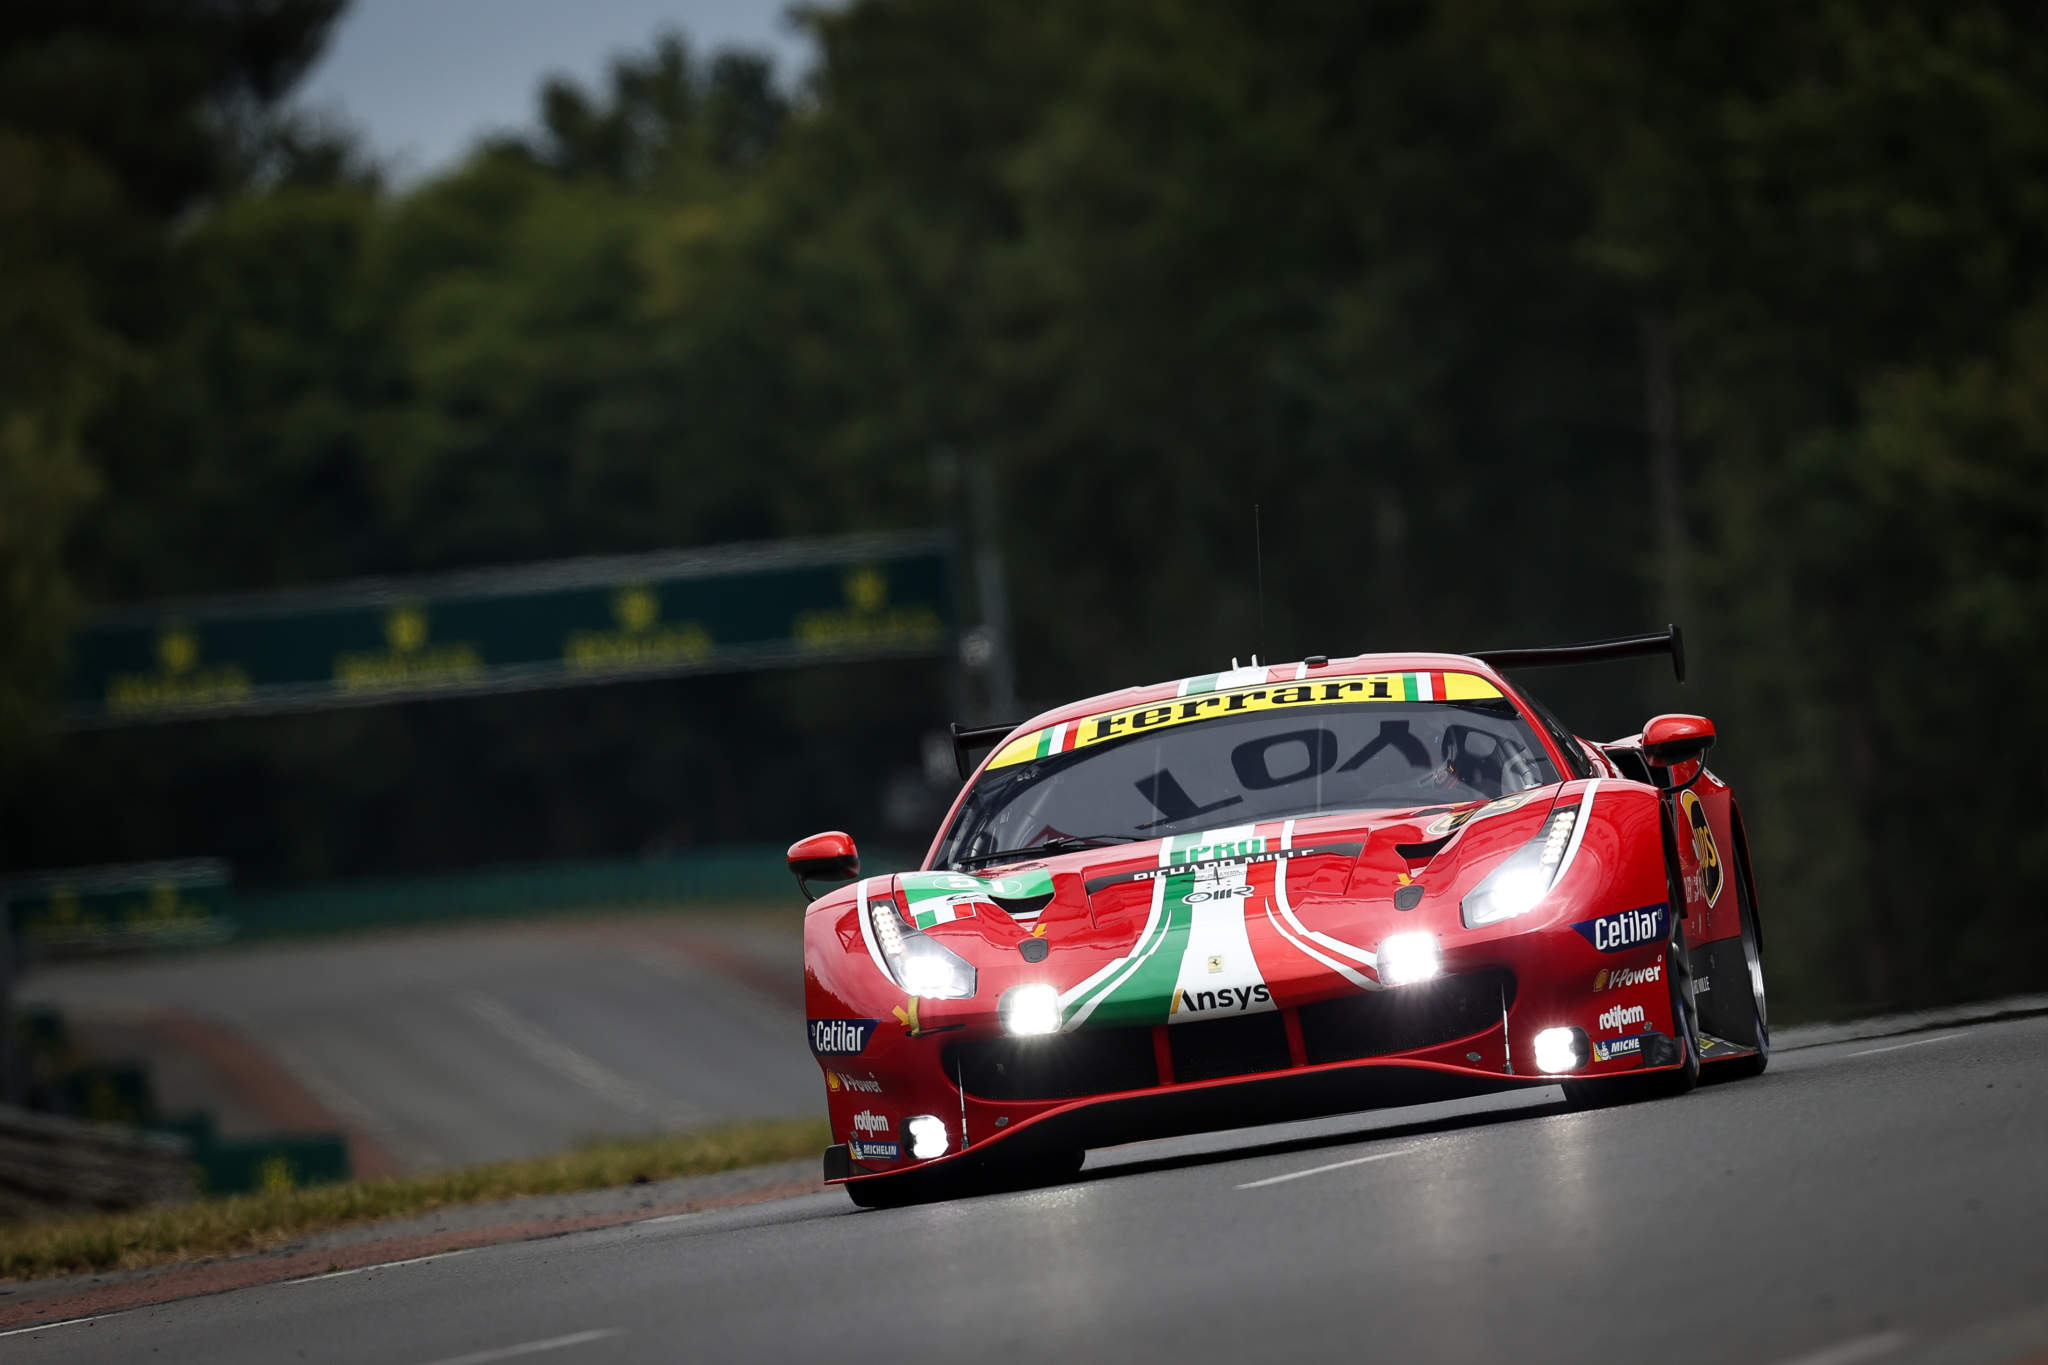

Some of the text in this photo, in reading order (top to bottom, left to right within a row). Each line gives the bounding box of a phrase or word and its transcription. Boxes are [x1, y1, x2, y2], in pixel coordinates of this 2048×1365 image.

[1086, 676, 1396, 743] Ferrari
[1595, 909, 1658, 950] Cetilar
[1608, 965, 1662, 990] V-Power
[1170, 983, 1270, 1015] Ansys
[1599, 1004, 1645, 1034] rotiform
[816, 1020, 865, 1052] Cetilar
[838, 1072, 883, 1094] V-Power
[853, 1109, 890, 1138] rotiform
[863, 1143, 897, 1156] MICHELIN
